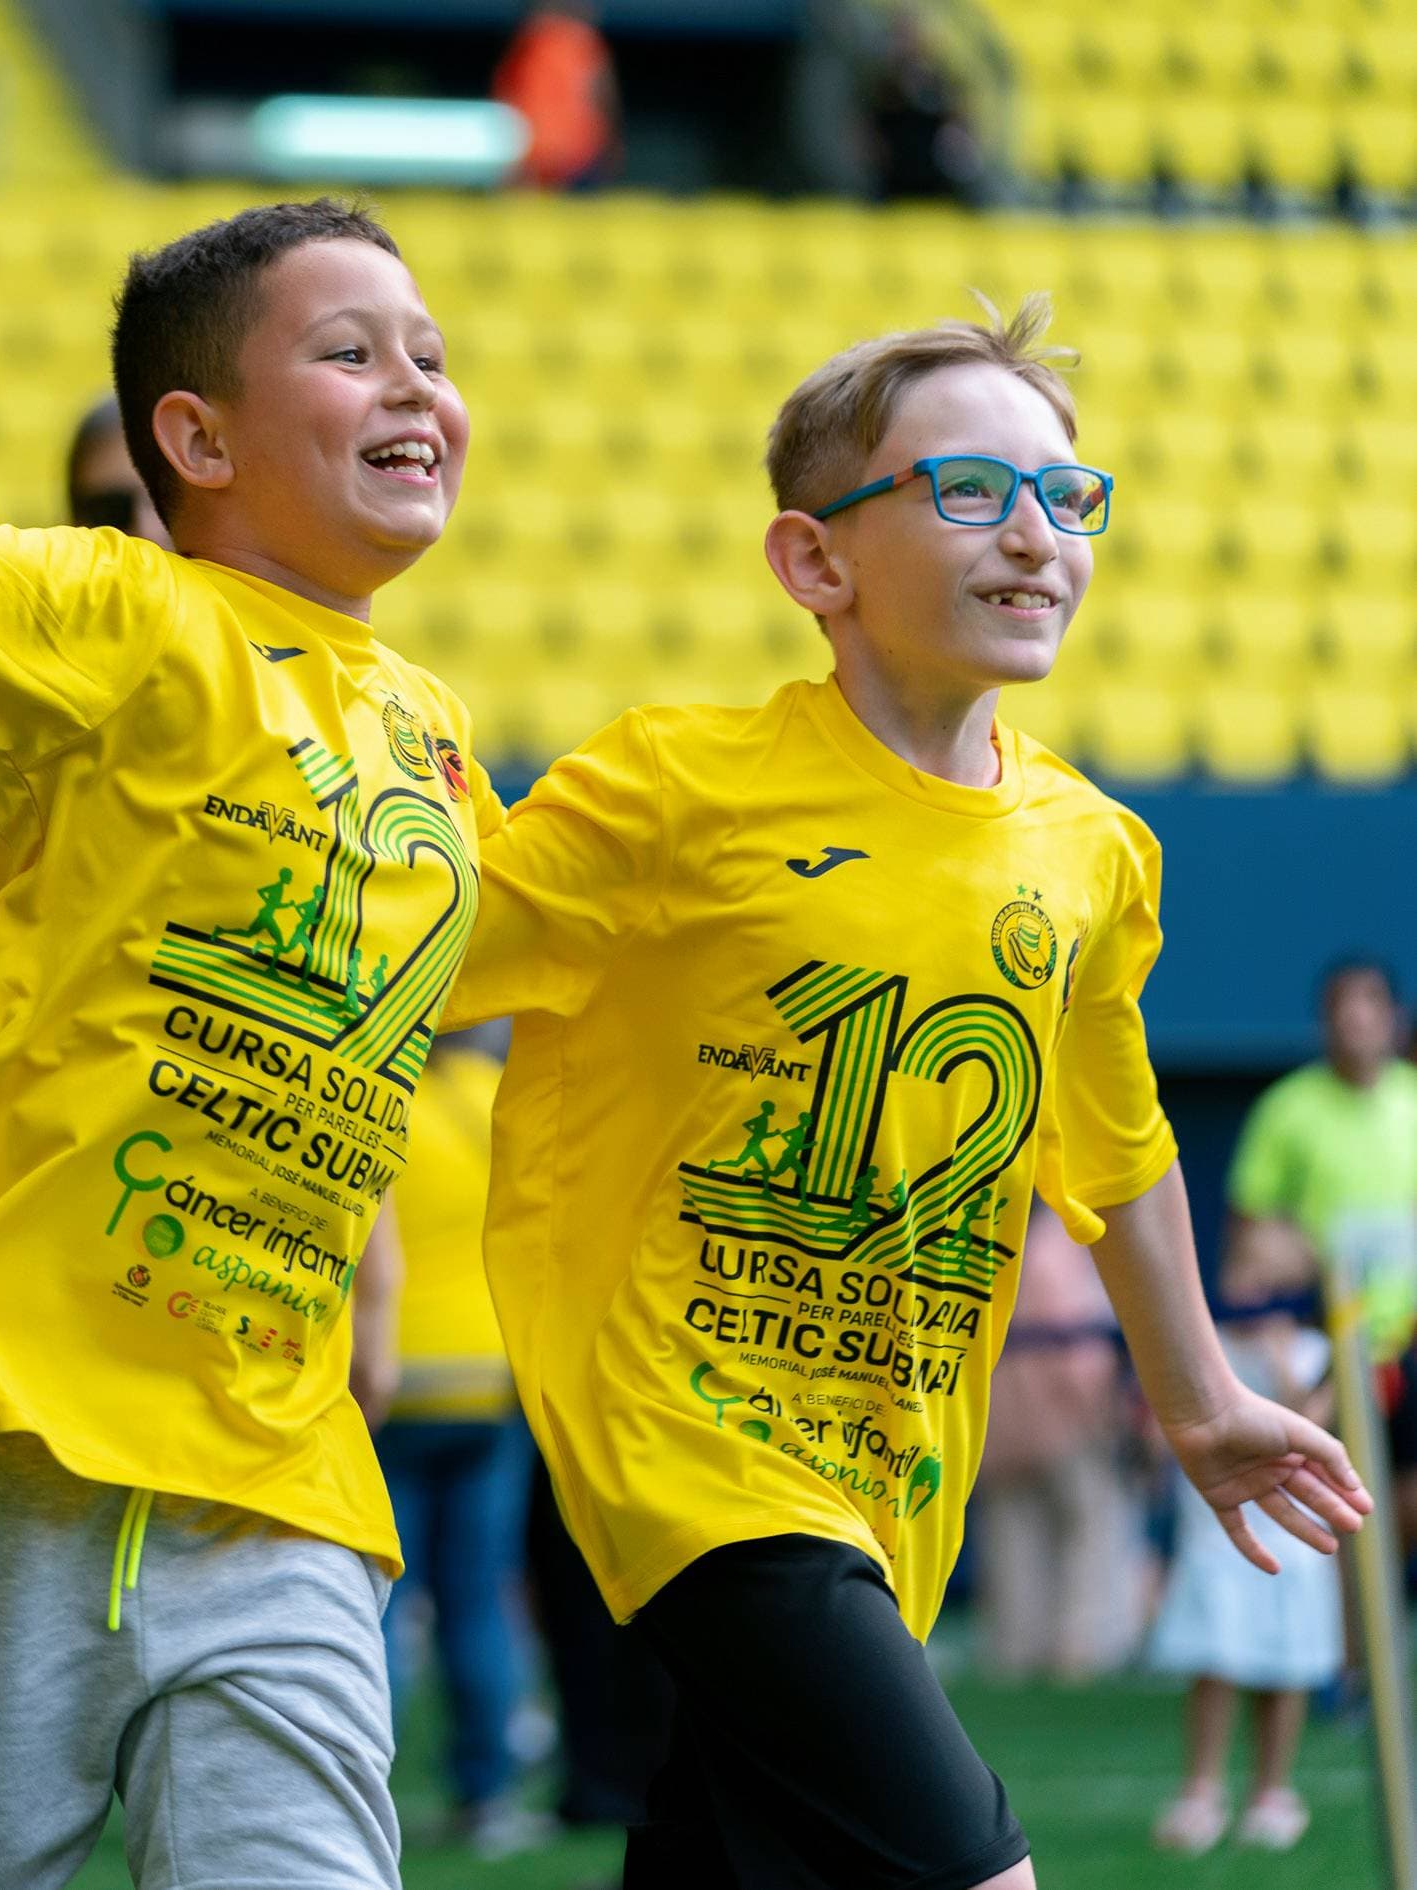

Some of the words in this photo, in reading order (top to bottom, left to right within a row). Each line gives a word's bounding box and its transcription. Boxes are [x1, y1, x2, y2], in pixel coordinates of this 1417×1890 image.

[203, 793, 328, 852] ENDAVANT
[149, 737, 479, 1096] 12
[163, 1005, 312, 1092] CURSA
[320, 1066, 410, 1143] SOLIDA
[698, 1043, 812, 1083] ENDAVANT
[148, 1059, 301, 1153] CELTIC
[301, 1132, 400, 1206] SUBMA
[284, 1093, 317, 1122] PER
[316, 1107, 382, 1150] PARELLES
[678, 959, 1043, 1302] 12
[204, 1130, 271, 1173] MEMORIAL
[108, 1130, 267, 1242] Cáncer
[263, 1217, 350, 1288] infant
[684, 1297, 825, 1361] CELTIC
[797, 1300, 835, 1323] PER
[738, 1351, 808, 1377] MEMORIAL
[838, 1367, 892, 1392] MANUEL
[791, 1393, 803, 1406] A
